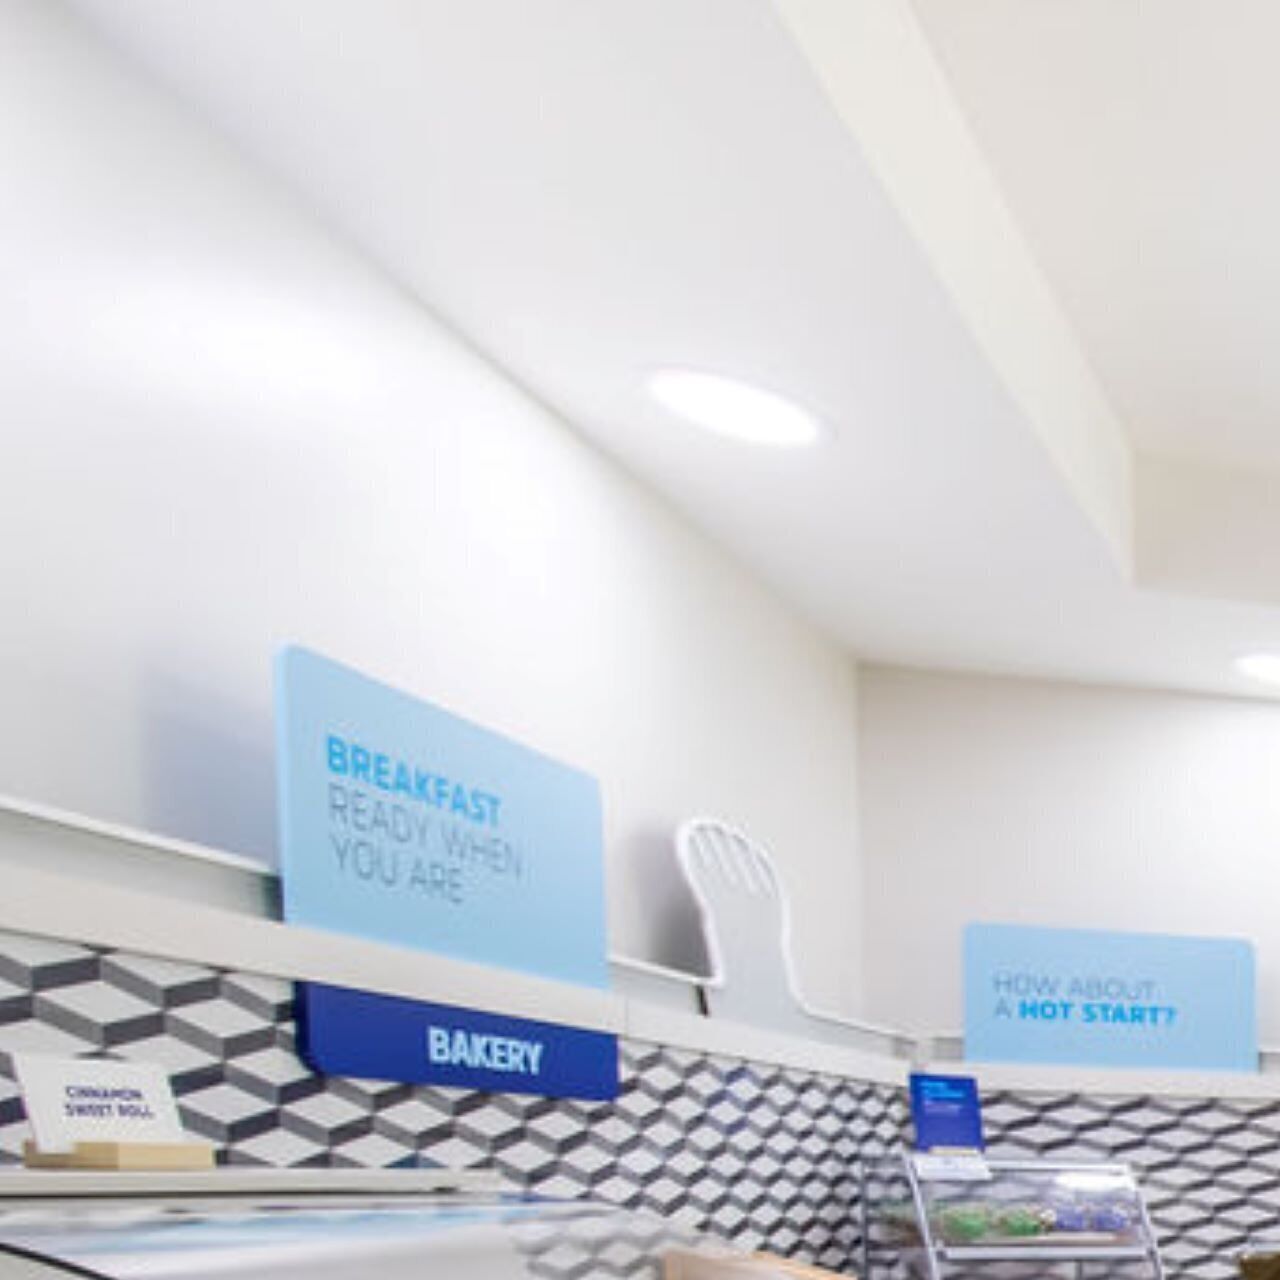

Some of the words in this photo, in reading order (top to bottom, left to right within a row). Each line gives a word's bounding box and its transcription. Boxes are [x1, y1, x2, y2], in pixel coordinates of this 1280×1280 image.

[327, 734, 501, 828] BREAKFAST
[327, 781, 428, 848] READY
[439, 817, 522, 882] WHEN
[327, 832, 398, 888] YOU
[409, 855, 464, 905] ARE
[992, 971, 1061, 997] HOW
[1069, 976, 1155, 1001] ABOUT
[993, 997, 1012, 1020] A
[1018, 999, 1075, 1021] HOT
[1082, 1001, 1177, 1026] START?
[428, 1025, 544, 1077] BAKERY
